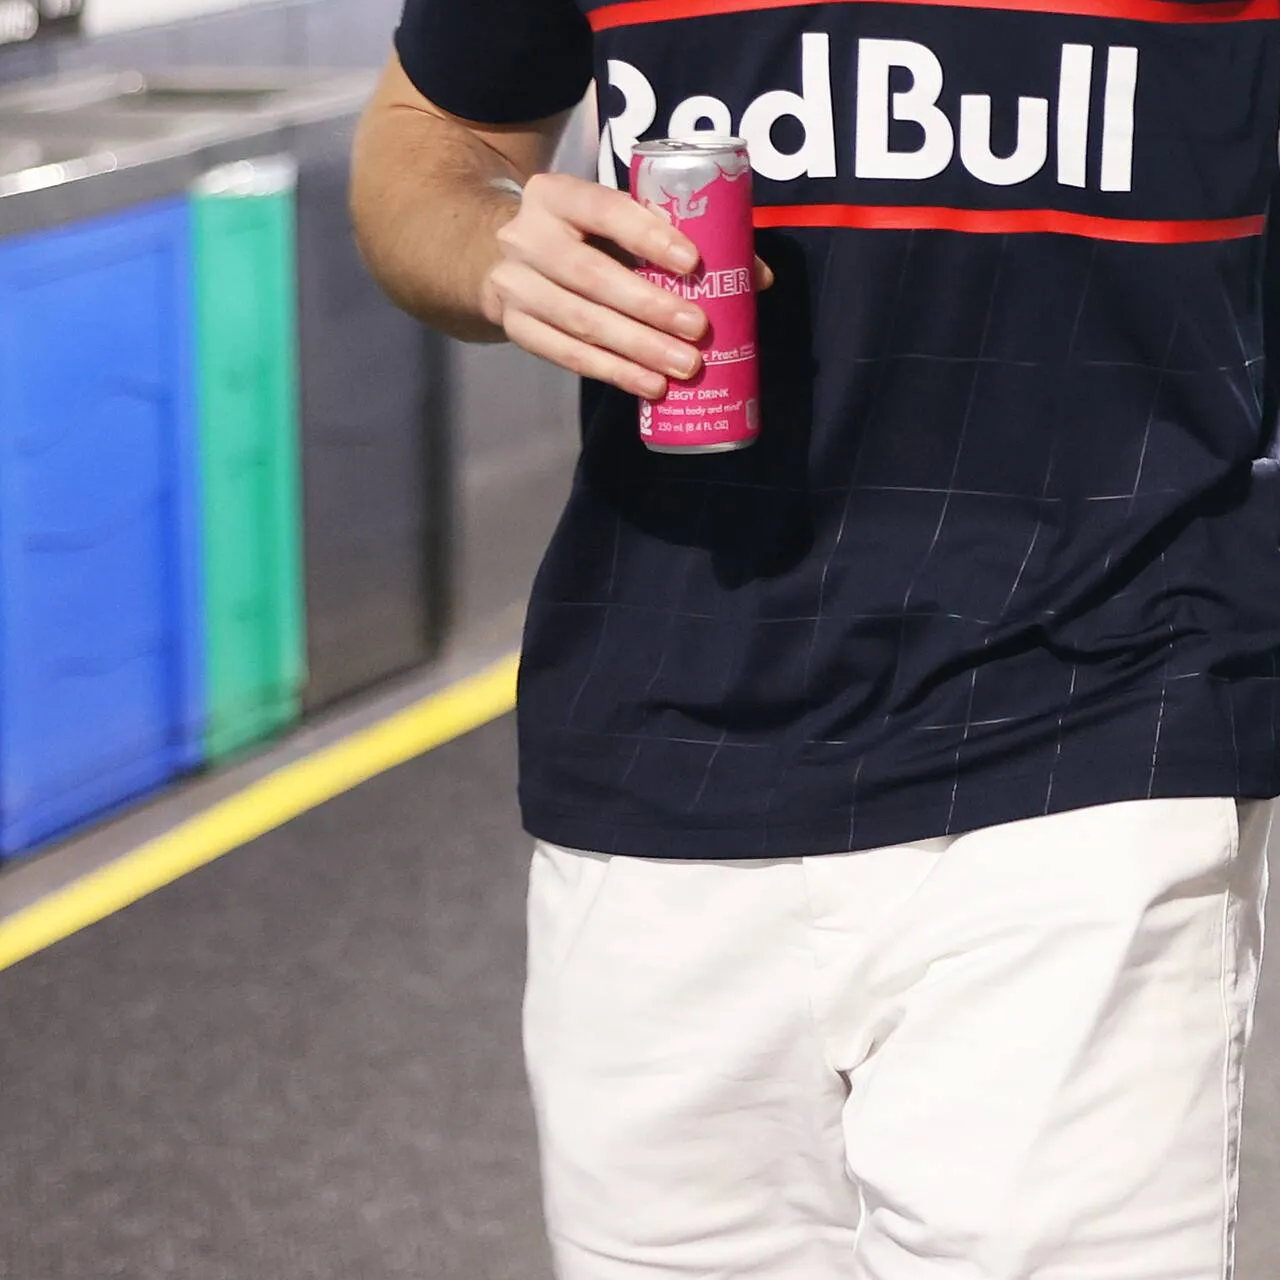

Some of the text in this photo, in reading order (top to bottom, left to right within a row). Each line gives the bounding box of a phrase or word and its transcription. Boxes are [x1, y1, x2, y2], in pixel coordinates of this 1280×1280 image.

[642, 267, 751, 300] MMER
[666, 388, 729, 401] ERGY DRINK
